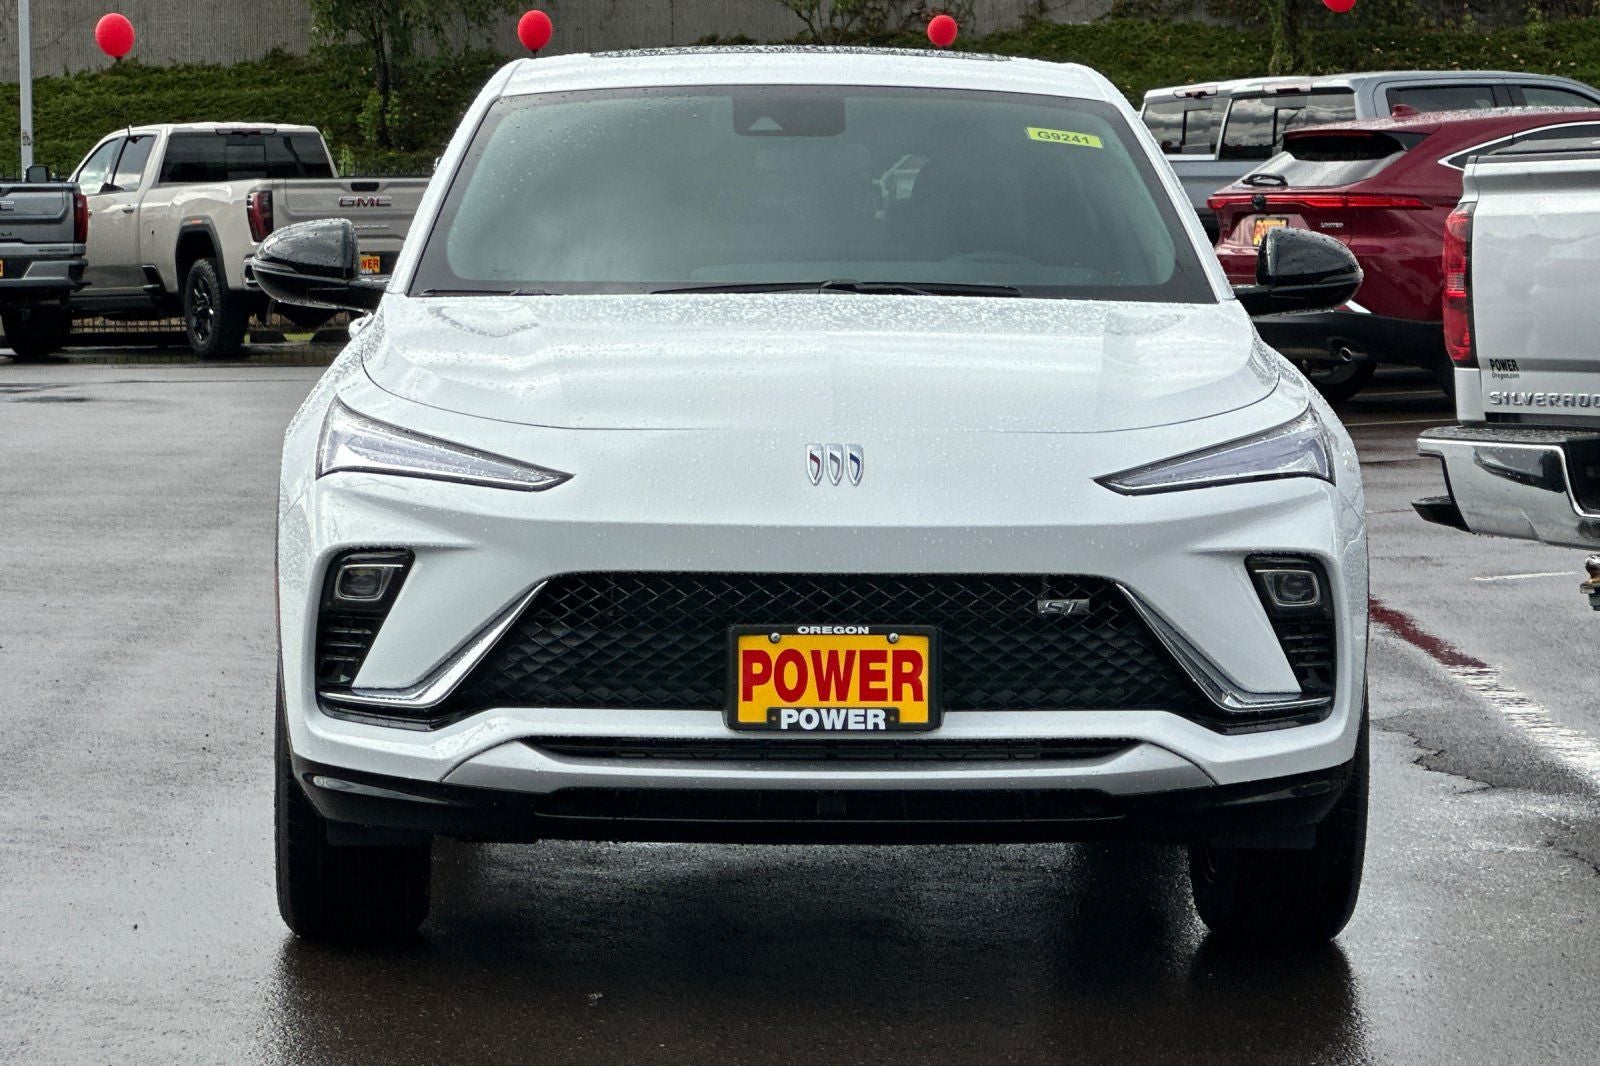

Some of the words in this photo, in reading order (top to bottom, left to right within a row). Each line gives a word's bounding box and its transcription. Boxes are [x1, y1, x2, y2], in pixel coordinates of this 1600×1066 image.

[1037, 131, 1090, 145] G9241
[339, 196, 392, 208] GMC
[361, 258, 379, 269] WER
[1489, 359, 1520, 371] POWER
[1492, 372, 1520, 380] Oregon.com
[797, 626, 870, 635] OREGON
[742, 648, 924, 703] POWER
[780, 708, 886, 730] POWER
